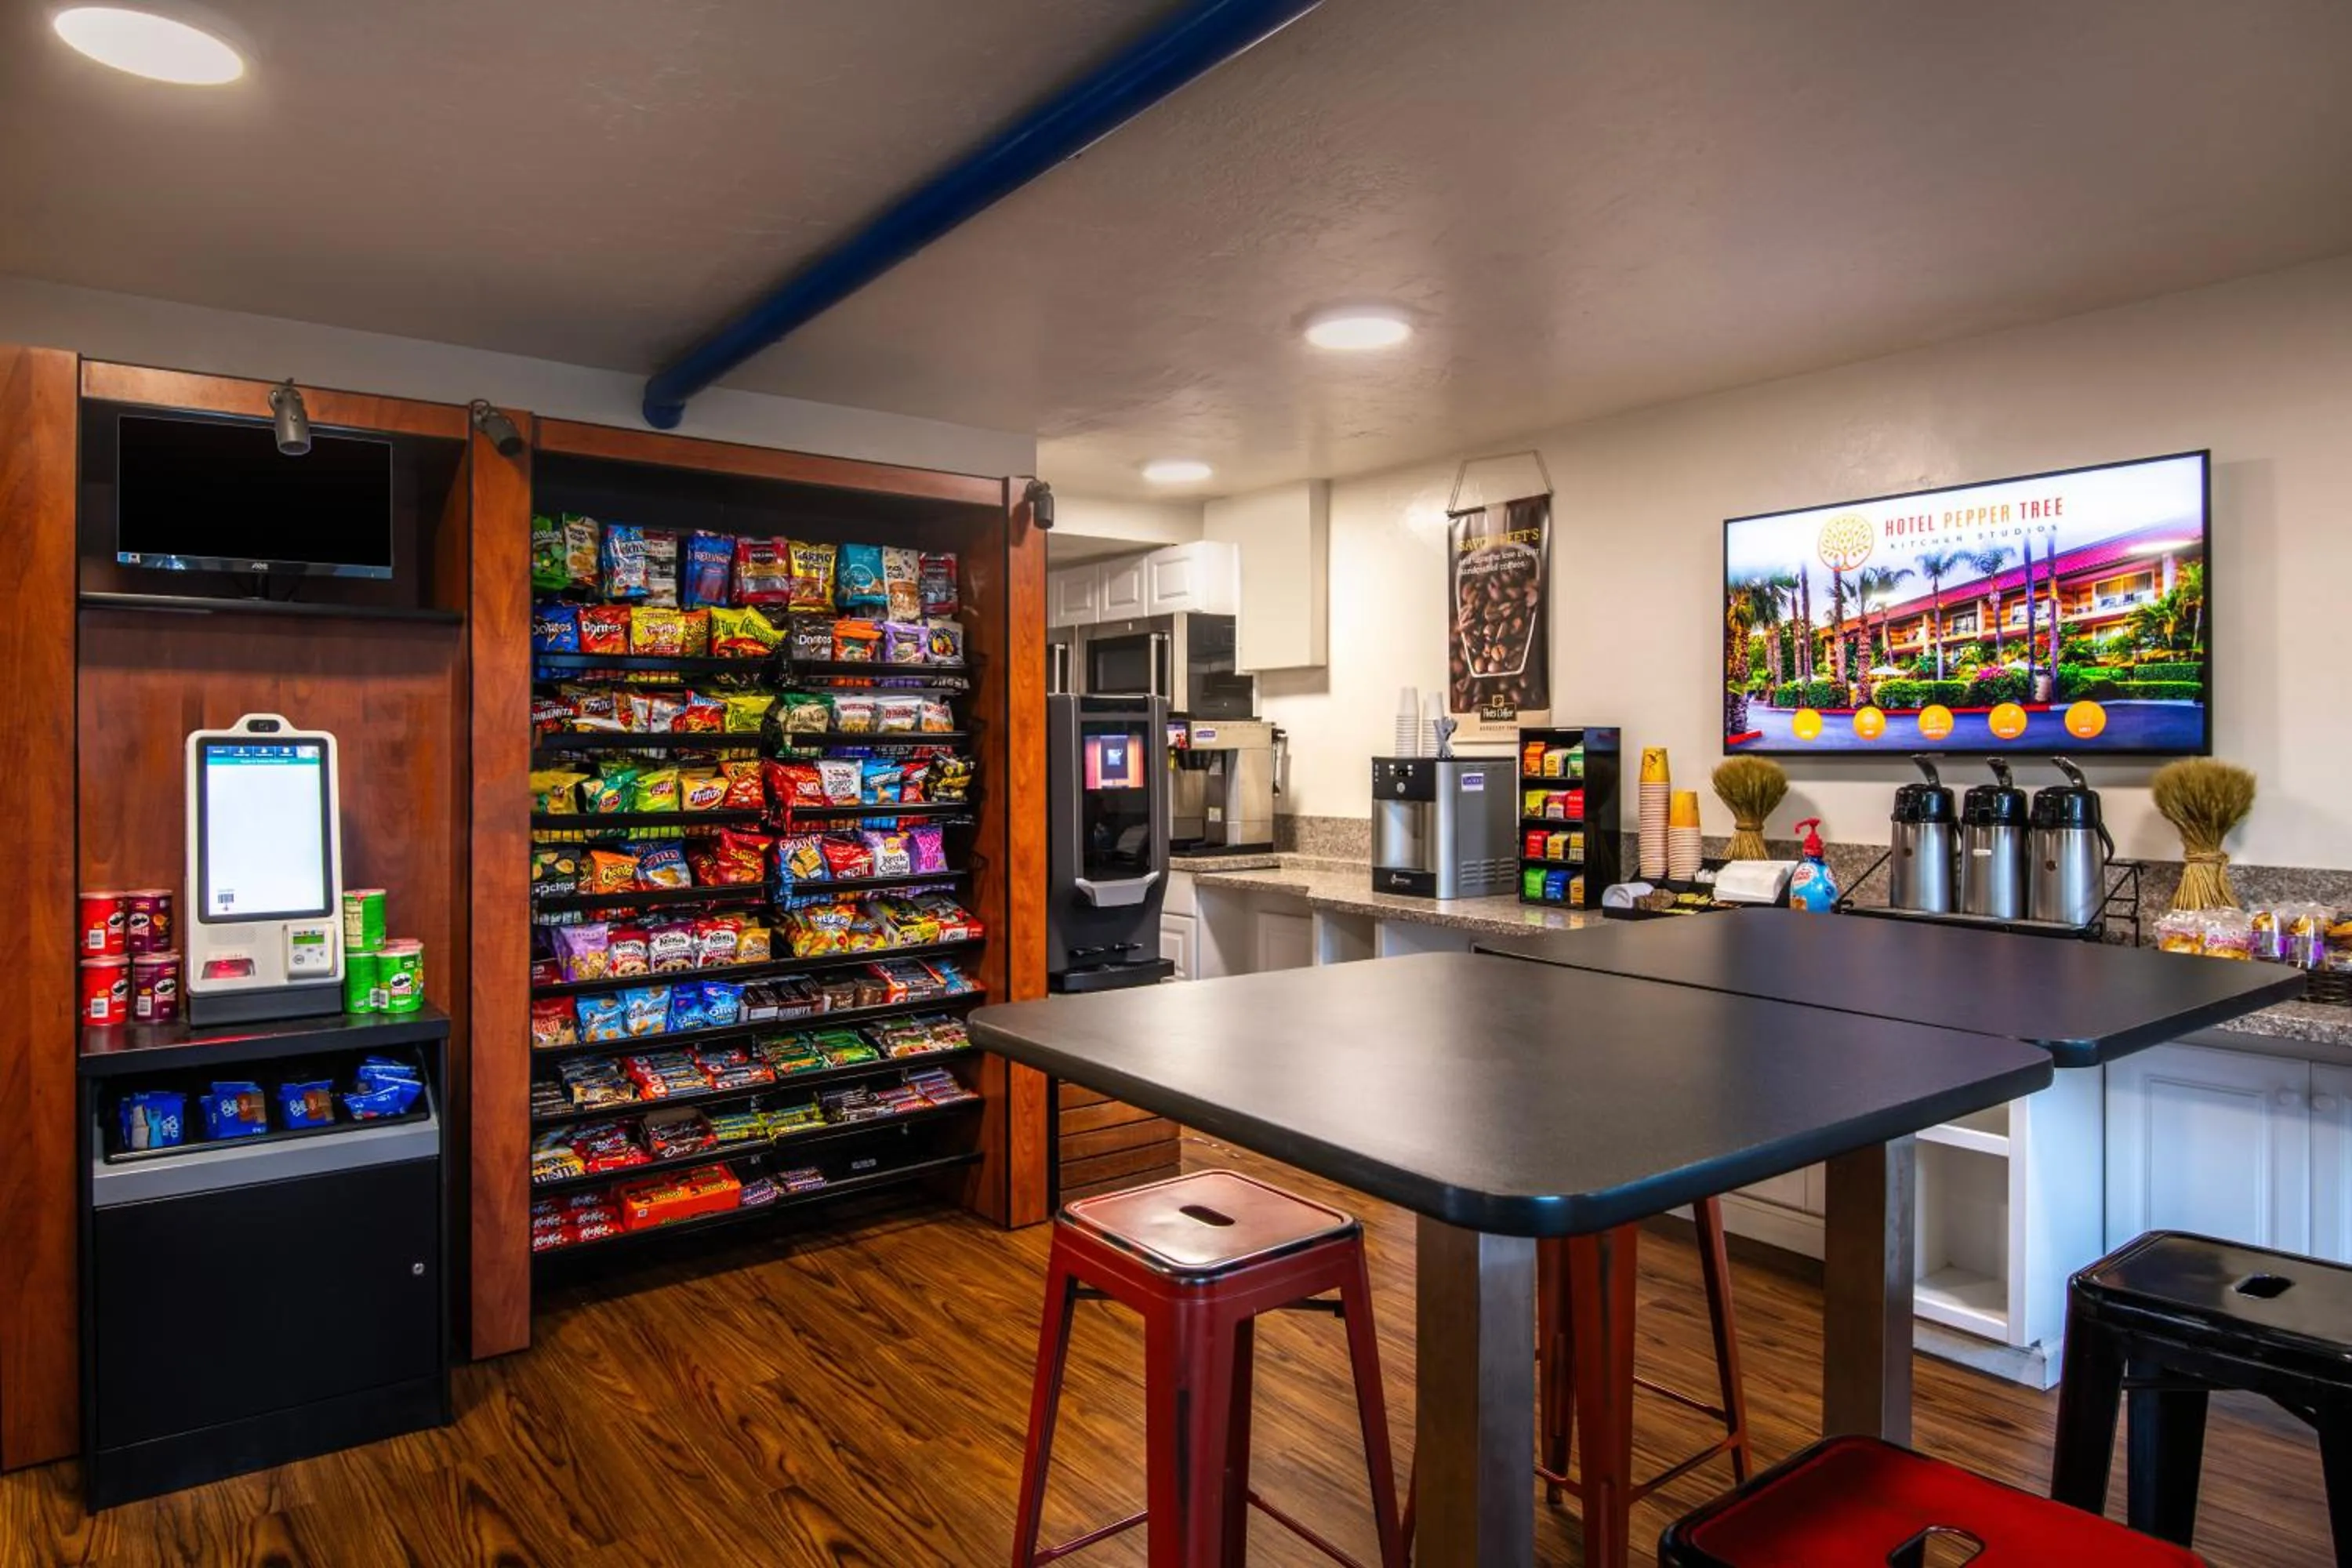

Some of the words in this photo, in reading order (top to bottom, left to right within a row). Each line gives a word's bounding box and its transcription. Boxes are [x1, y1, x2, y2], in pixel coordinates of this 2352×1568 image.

[1886, 514, 1935, 536] HOTEL
[1944, 504, 2009, 528] PEPPER
[2020, 497, 2063, 519] TREE
[1890, 535, 1962, 549] KITCHEN
[1979, 524, 2058, 539] STUDIOS
